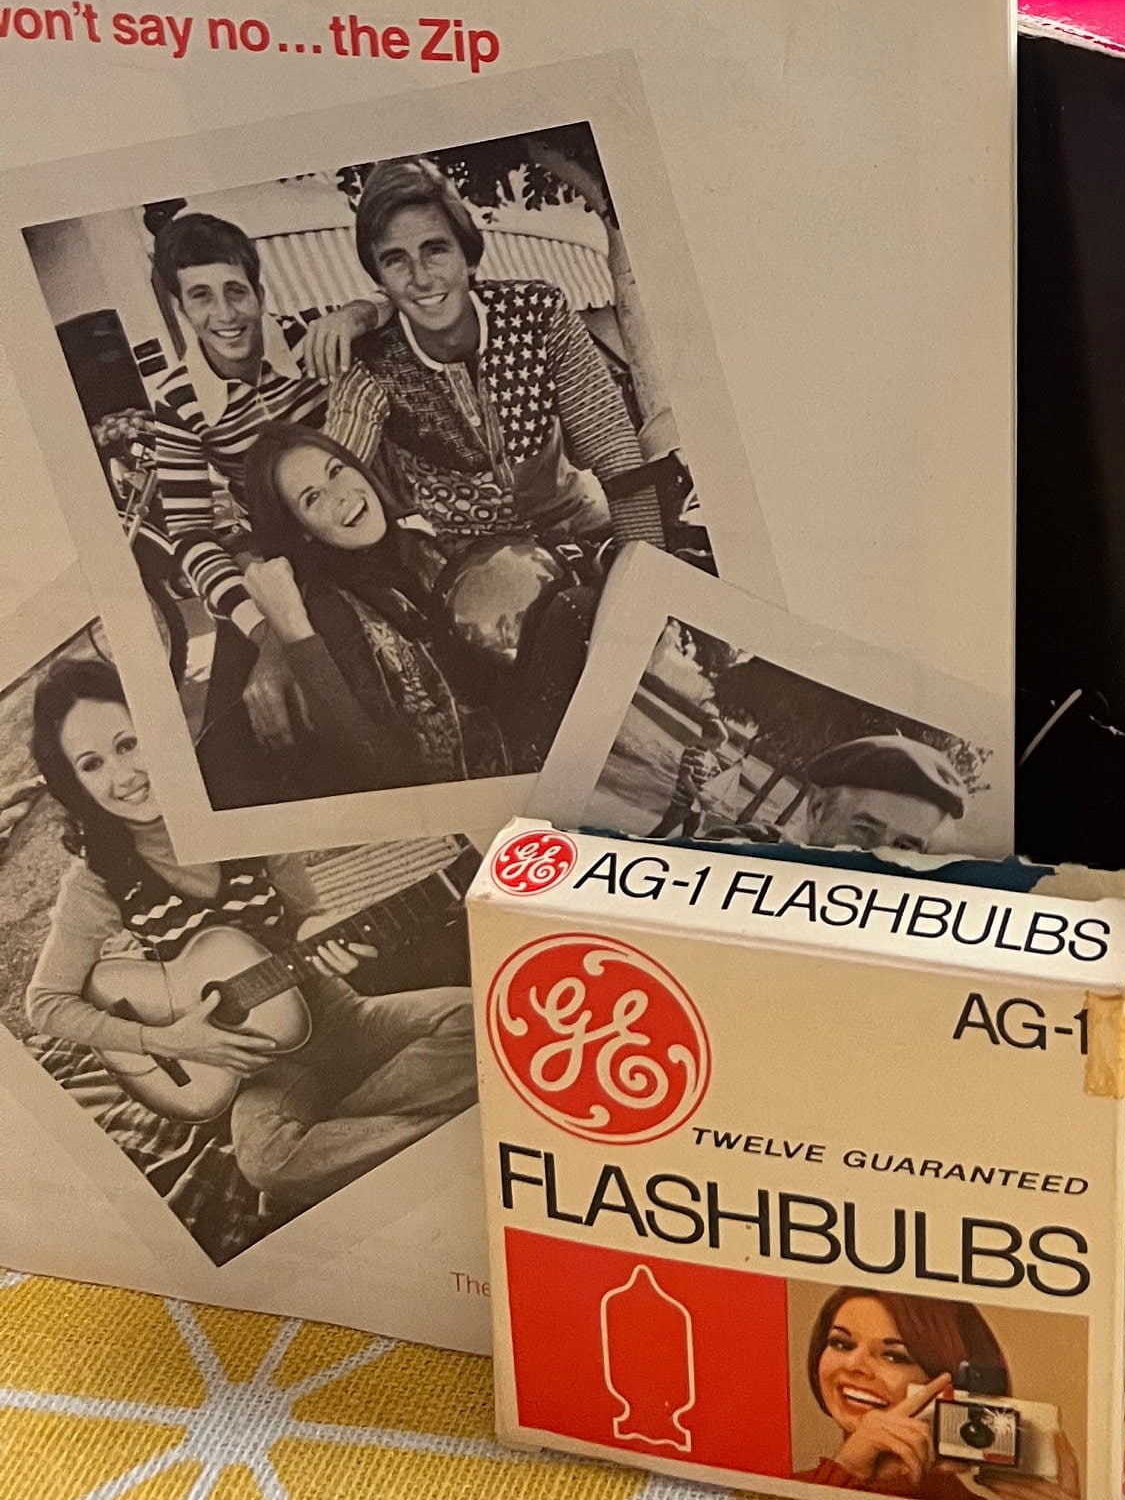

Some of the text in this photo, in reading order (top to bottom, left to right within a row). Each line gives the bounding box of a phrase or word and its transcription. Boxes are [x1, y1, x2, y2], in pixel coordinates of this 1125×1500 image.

[0, 1, 101, 43] on't
[112, 12, 194, 59] say
[418, 17, 500, 74] Zip
[573, 851, 1111, 962] AG-1 FLASHBULBS
[953, 991, 1090, 1056] AG-1
[692, 1127, 1090, 1197] TWELVE GUARANTEED
[498, 1140, 1093, 1298] FLASHBULBS
[449, 1271, 491, 1297] The
